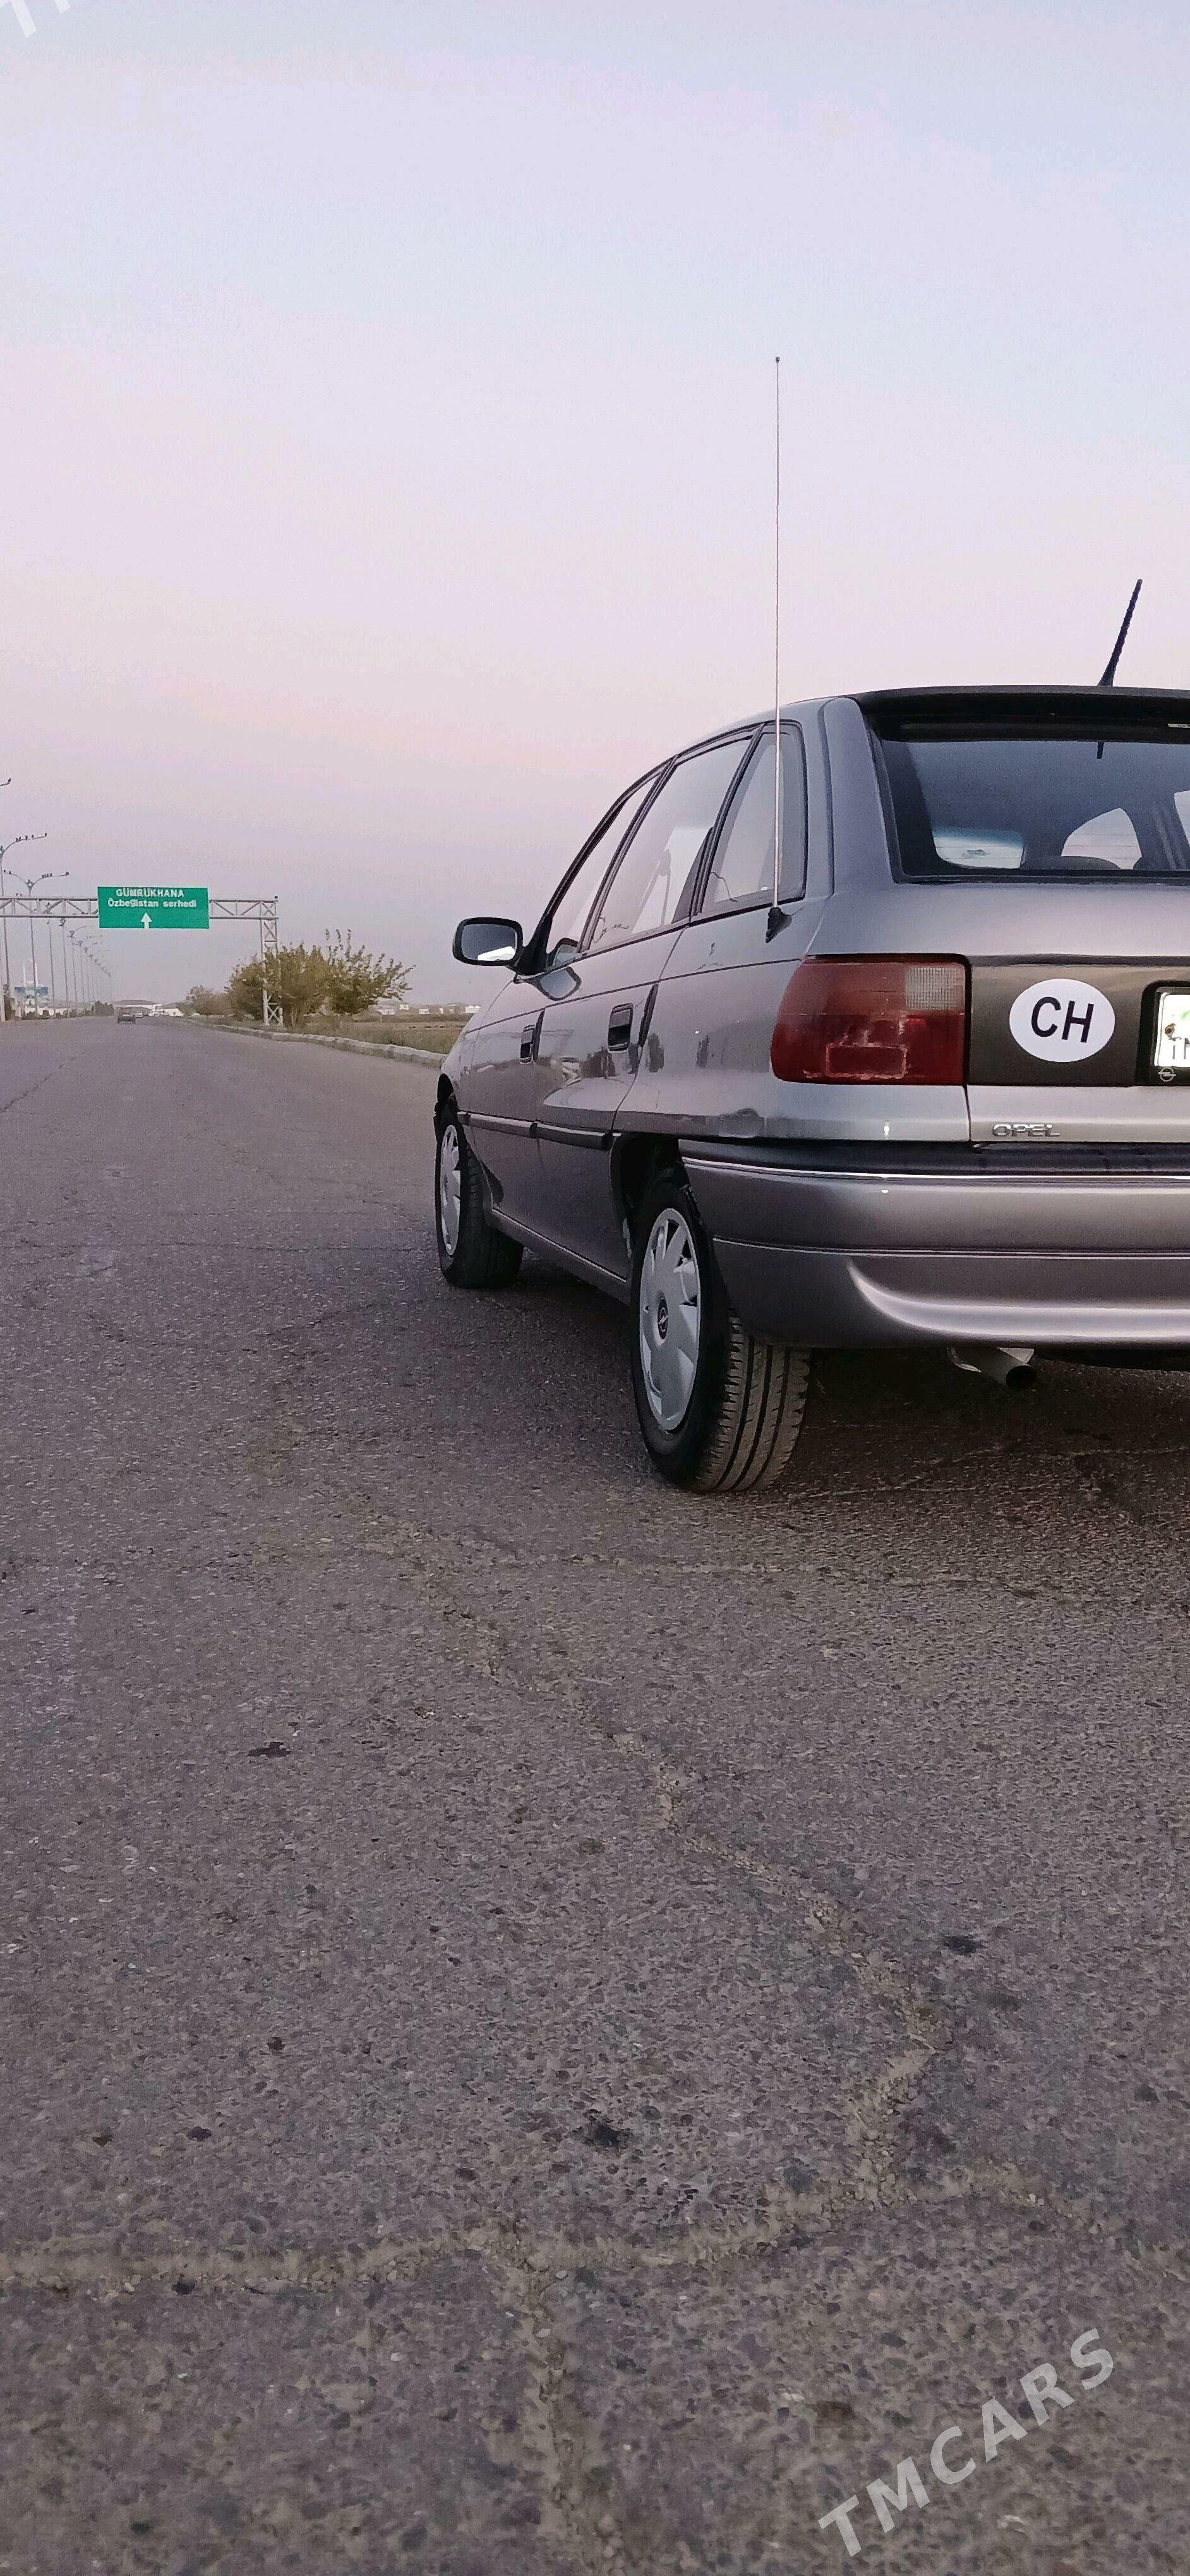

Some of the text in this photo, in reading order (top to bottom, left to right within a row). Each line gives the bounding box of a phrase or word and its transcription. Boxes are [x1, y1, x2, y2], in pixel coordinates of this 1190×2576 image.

[163, 899, 197, 907] serhedi
[1031, 996, 1095, 1043] CH
[992, 1124, 1061, 1137] OPEL
